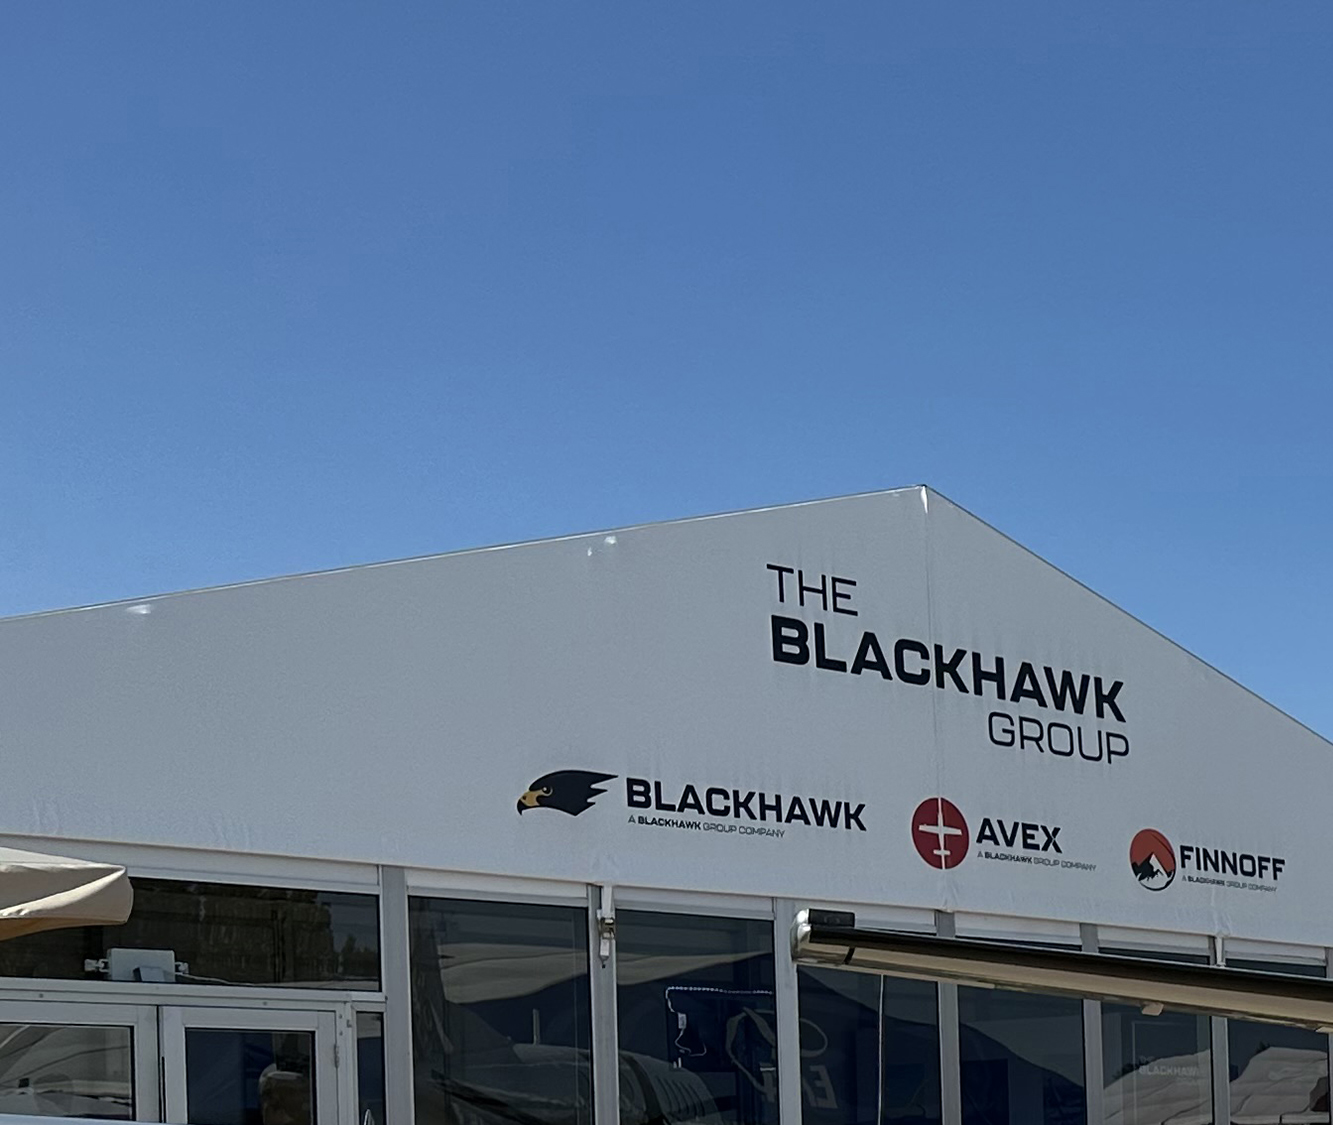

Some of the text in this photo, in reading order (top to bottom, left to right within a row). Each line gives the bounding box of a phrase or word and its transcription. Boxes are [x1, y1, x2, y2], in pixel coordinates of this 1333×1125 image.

[766, 563, 859, 617] THE
[771, 614, 1127, 723] BLACKHAWK
[988, 711, 1130, 764] GROUP
[626, 777, 867, 832] BLACKHAWK
[628, 815, 785, 838] A BLACKHAWK GROUP COMPANY
[976, 817, 1063, 854] AVEX
[984, 851, 1033, 864] BLACKHAWK
[1180, 844, 1285, 881] FINNOFF
